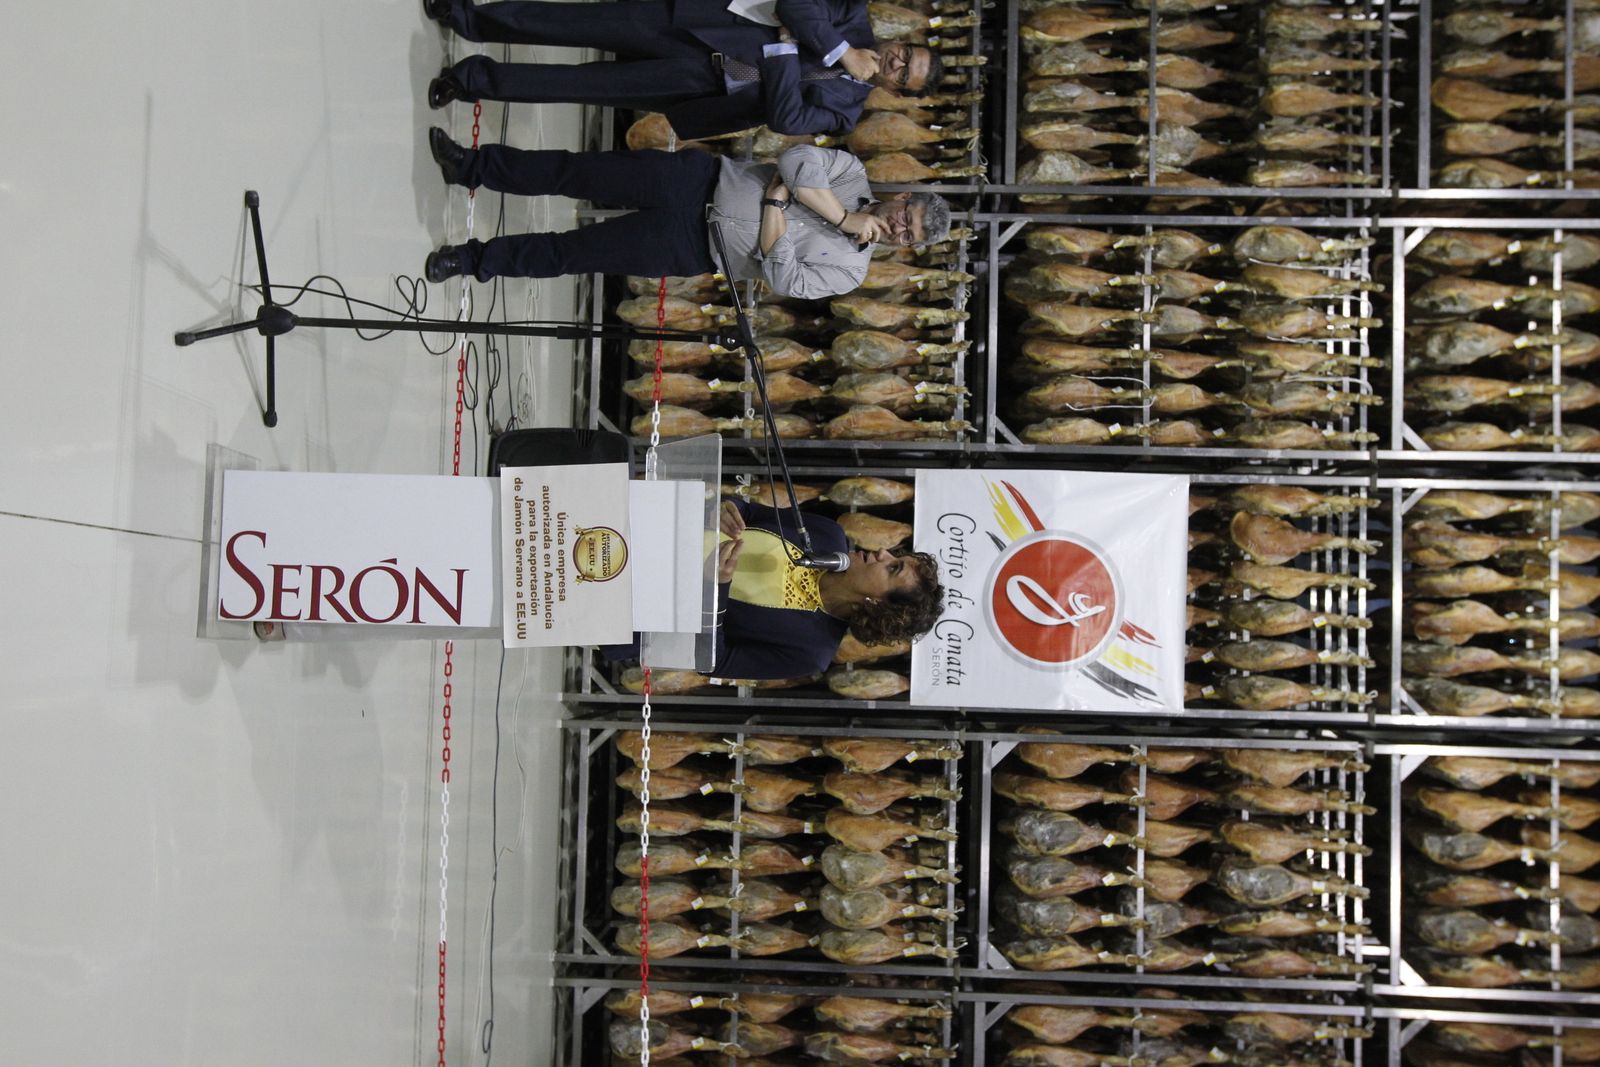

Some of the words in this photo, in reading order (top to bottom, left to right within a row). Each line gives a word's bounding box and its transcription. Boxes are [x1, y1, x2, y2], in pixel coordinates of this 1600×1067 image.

[514, 477, 523, 492] de
[514, 495, 525, 535] Jamón
[526, 500, 536, 527] para
[542, 485, 552, 550] autorizada
[556, 512, 569, 545] Única
[529, 531, 539, 542] la
[937, 513, 976, 579] Cortijo
[515, 538, 525, 588] Serrano
[543, 554, 551, 567] en
[556, 549, 566, 602] empresa
[516, 591, 523, 599] a
[527, 545, 541, 616] exportación
[948, 588, 975, 609] de
[543, 571, 555, 630] Andalucía
[516, 602, 527, 640] EE.UU
[935, 619, 974, 686] Canata
